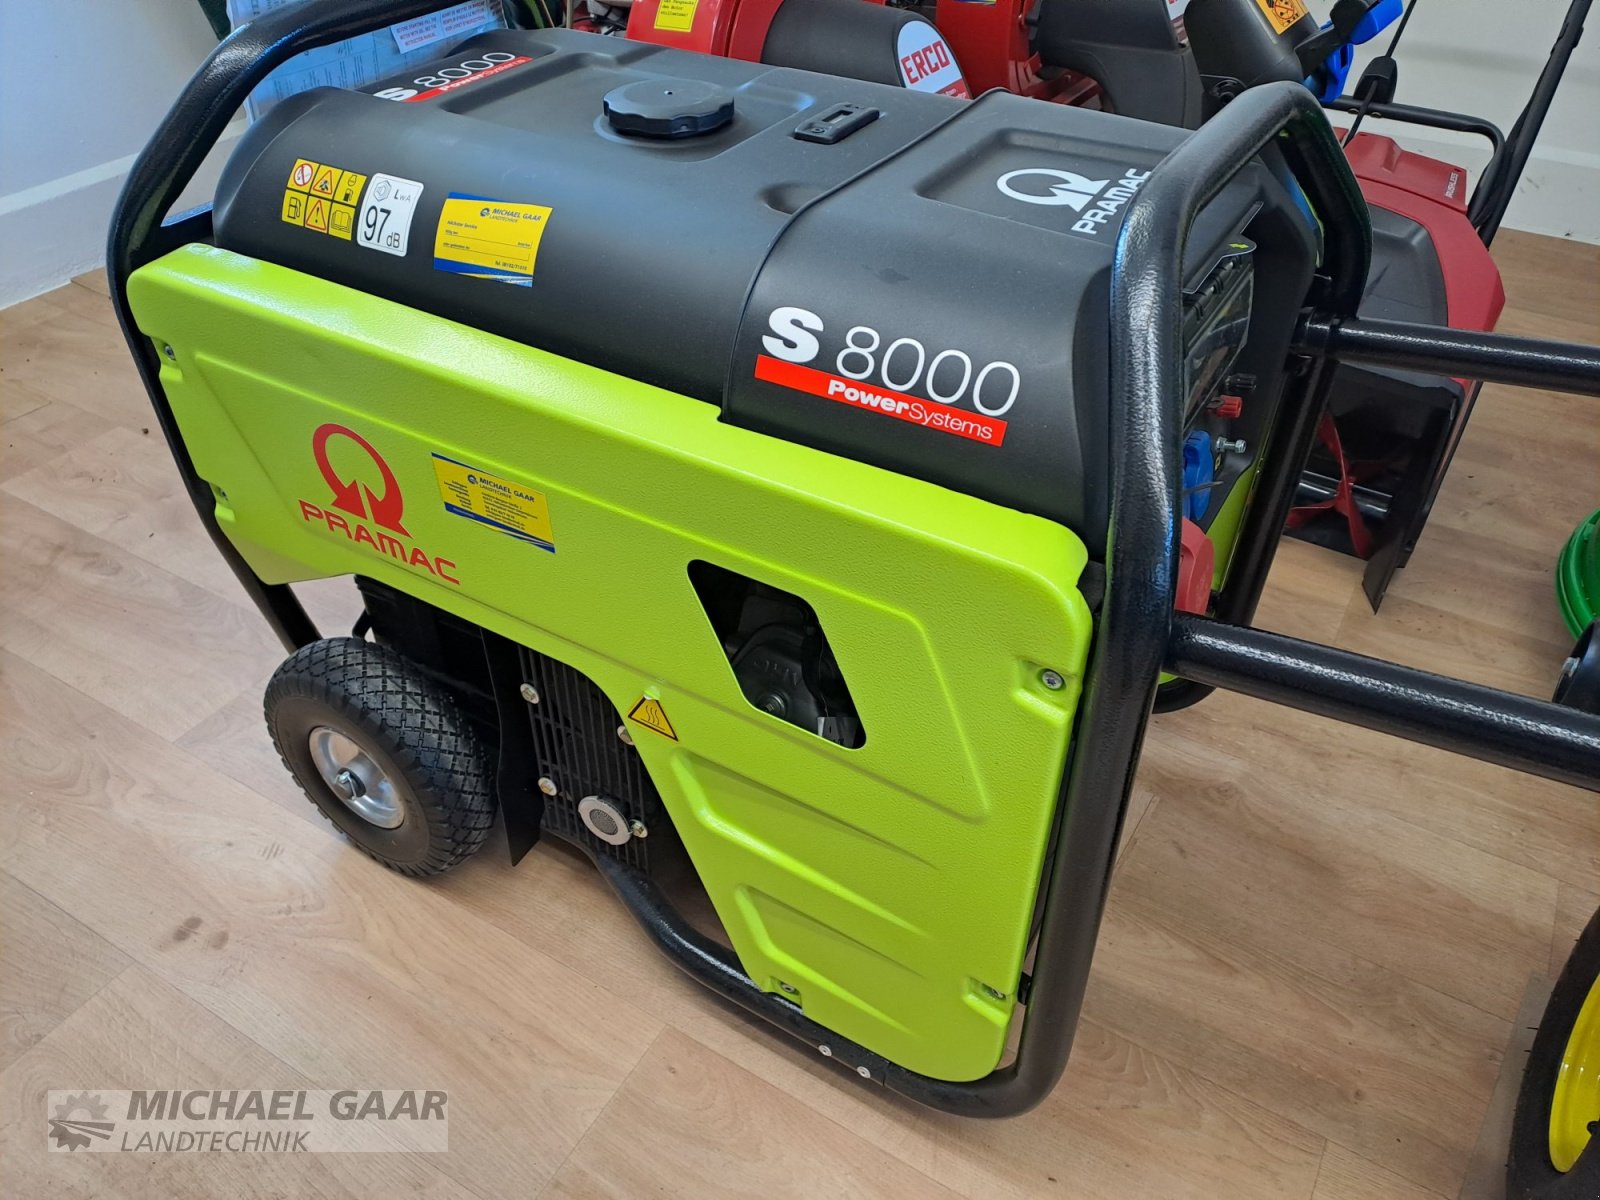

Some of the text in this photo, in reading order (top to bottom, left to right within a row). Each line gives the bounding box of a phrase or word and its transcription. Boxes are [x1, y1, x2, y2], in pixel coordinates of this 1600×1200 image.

[414, 52, 516, 87] 8000
[901, 40, 950, 84] ERCO
[491, 208, 541, 221] MICHAEL GAAR
[1071, 168, 1152, 235] PRAMAC
[364, 205, 391, 243] 97
[386, 232, 400, 248] dB
[762, 306, 1020, 416] S 8000
[827, 379, 992, 440] PowerSystems
[479, 477, 512, 493] MICHAEL
[514, 490, 535, 502] GAAR
[298, 499, 461, 585] PRAMAC
